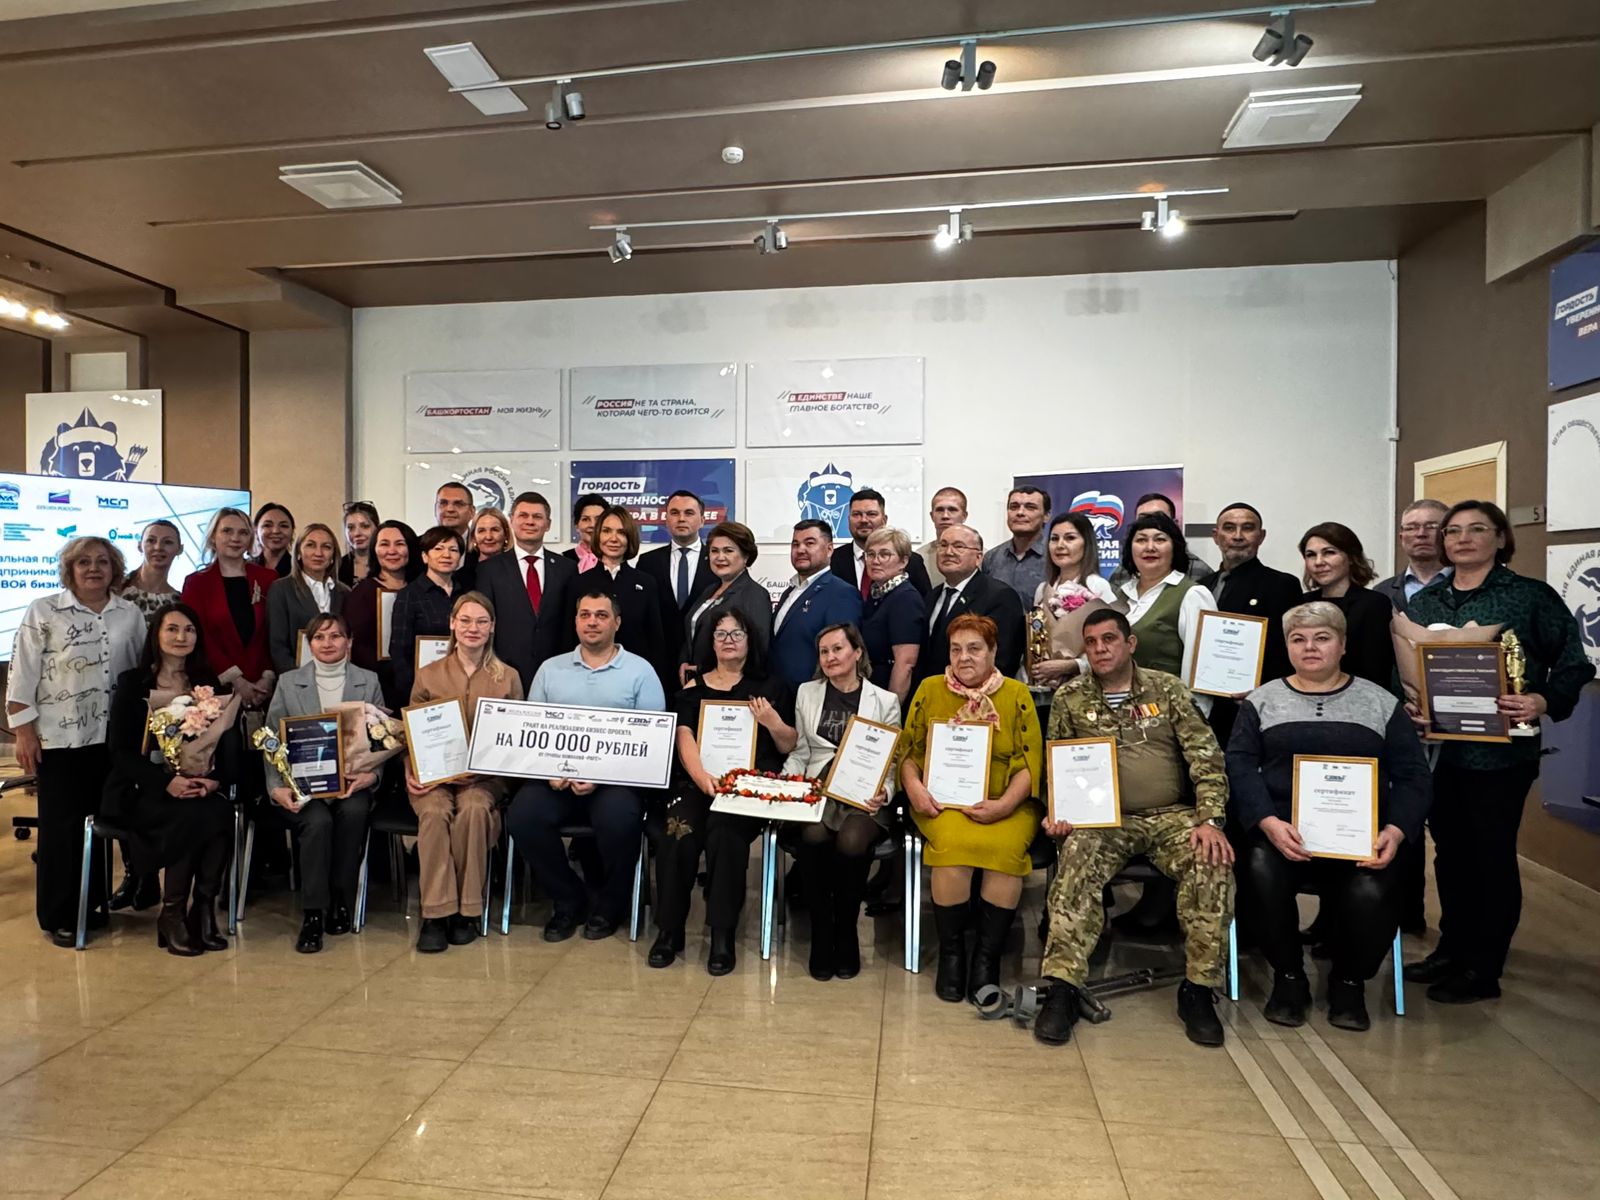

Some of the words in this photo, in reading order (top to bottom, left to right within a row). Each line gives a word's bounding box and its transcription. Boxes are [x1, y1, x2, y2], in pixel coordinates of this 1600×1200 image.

[797, 393, 844, 401] ЕДИНСТВЕ
[660, 398, 697, 406] СТРАНА,
[427, 407, 490, 415] БАШКОРТОСТАН
[790, 404, 828, 412] ГЛАВНОЕ
[830, 403, 879, 411] БОГАТСТВО
[581, 481, 641, 491] ГОРДОСТЬ
[98, 497, 129, 505] МСП
[650, 511, 658, 519] В
[1533, 507, 1540, 521] 5
[522, 721, 540, 729] ГРАНТ
[495, 732, 513, 747] НА
[518, 729, 550, 750] 100
[555, 732, 590, 753] 000
[595, 740, 649, 758] РУБЛЕЙ
